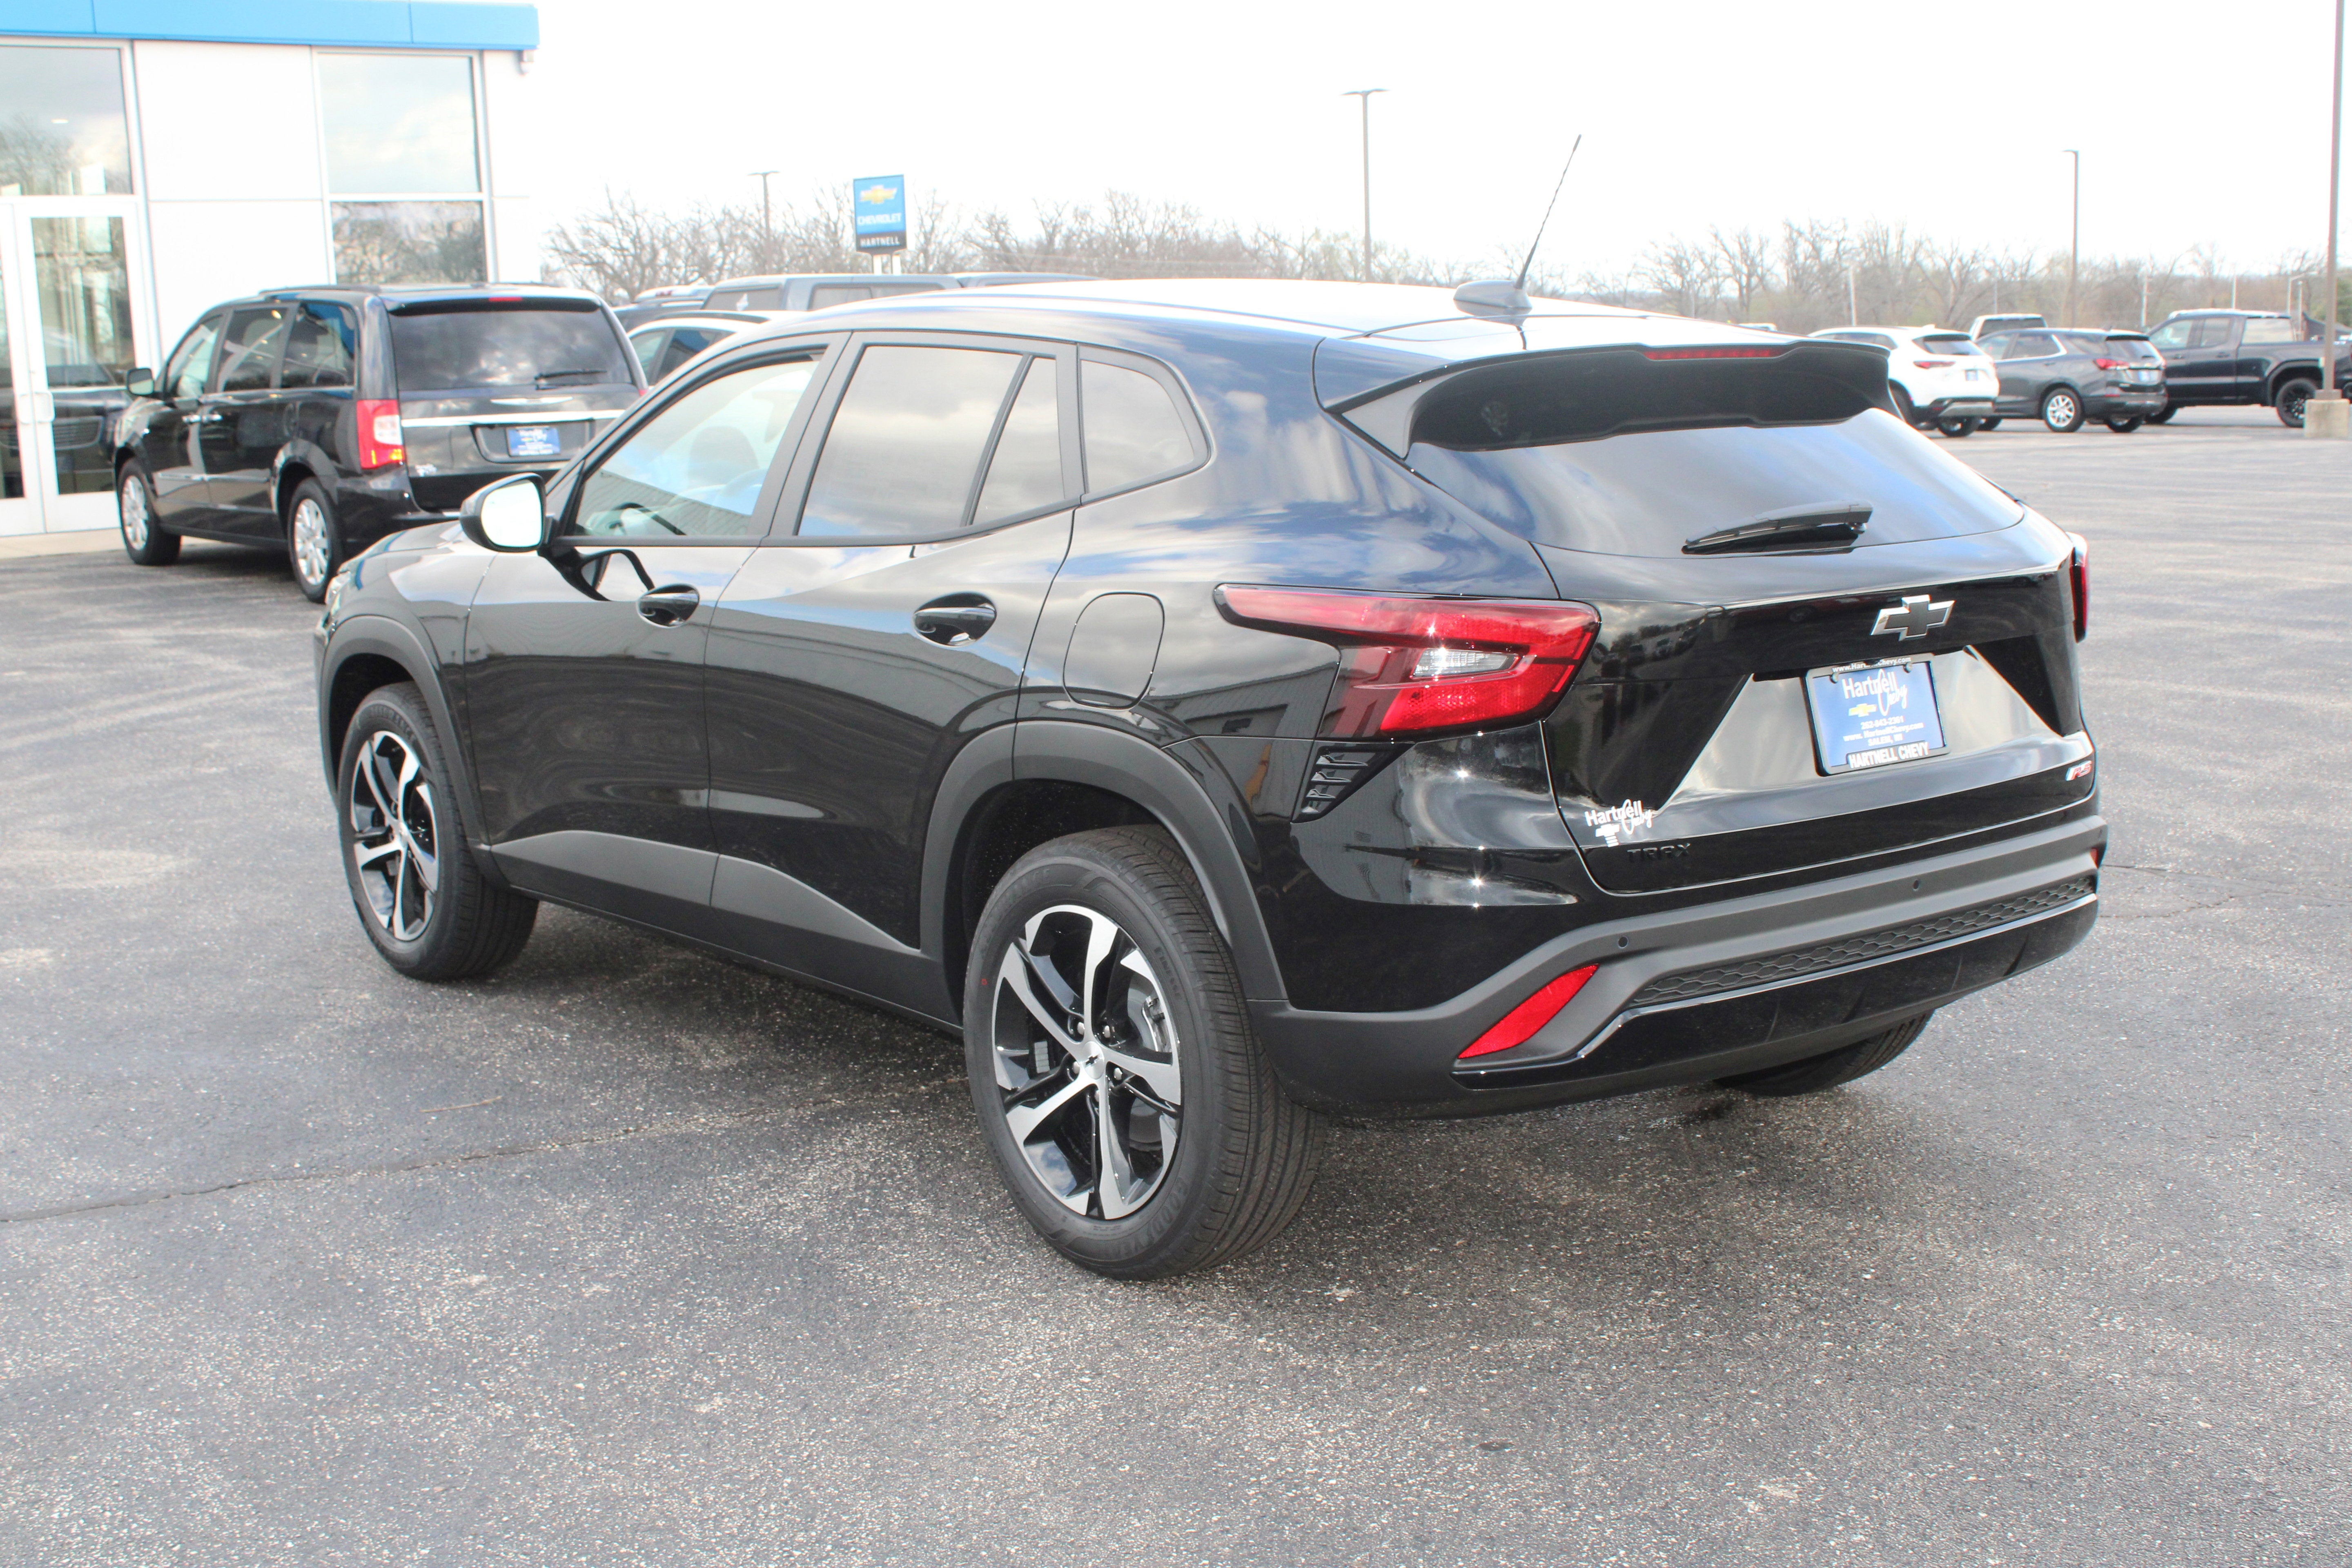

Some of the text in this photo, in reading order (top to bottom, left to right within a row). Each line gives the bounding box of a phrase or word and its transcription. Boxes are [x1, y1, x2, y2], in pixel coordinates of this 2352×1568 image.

[858, 213, 901, 225] CHEVROLET
[860, 236, 900, 247] HARTNELL
[1832, 657, 1911, 672] www.HartChevy.com
[1842, 672, 1898, 699] Hartnell
[1849, 742, 1929, 768] HARTNELL CHEVY
[2065, 760, 2093, 781] RS
[1584, 800, 1644, 827] Hartnell
